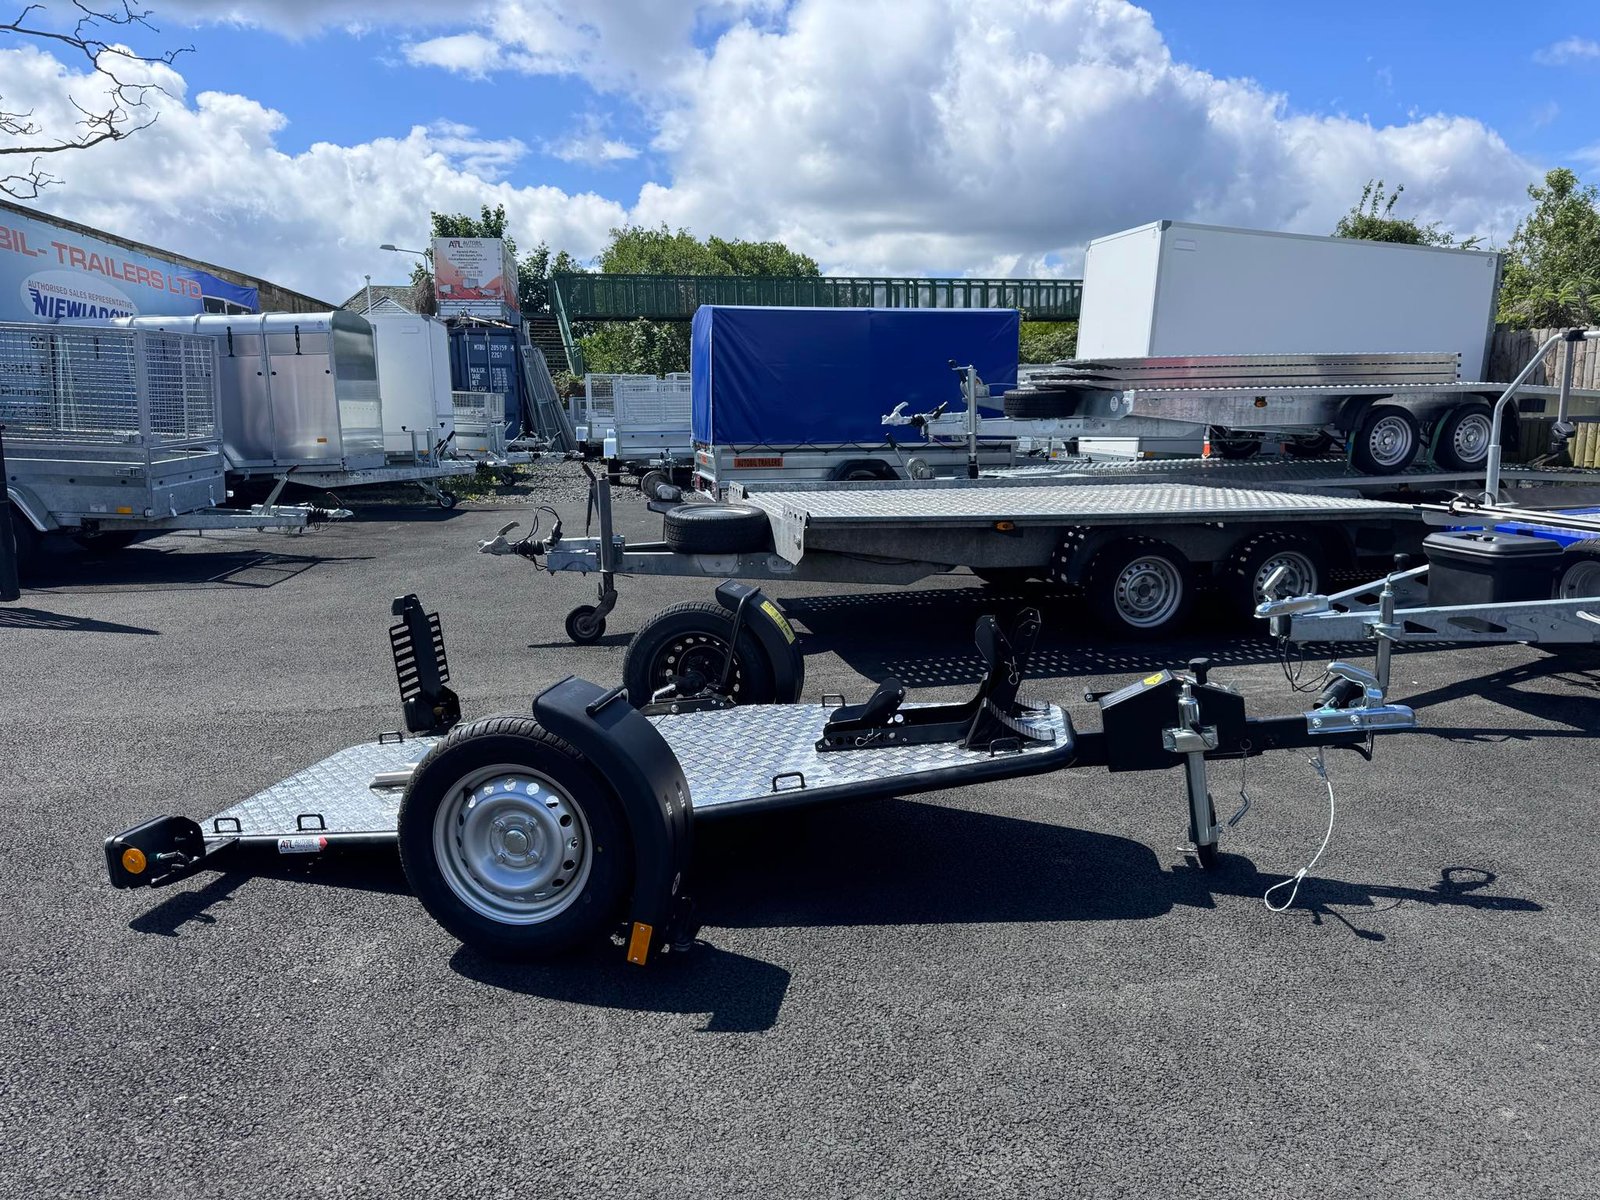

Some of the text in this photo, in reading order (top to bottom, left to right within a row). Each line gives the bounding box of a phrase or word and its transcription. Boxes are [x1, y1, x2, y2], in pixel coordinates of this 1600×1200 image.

[51, 241, 164, 290] TRAILERS
[167, 275, 202, 299] LTD
[28, 279, 133, 309] AUTHORISED SALES REPRESENTATIVE
